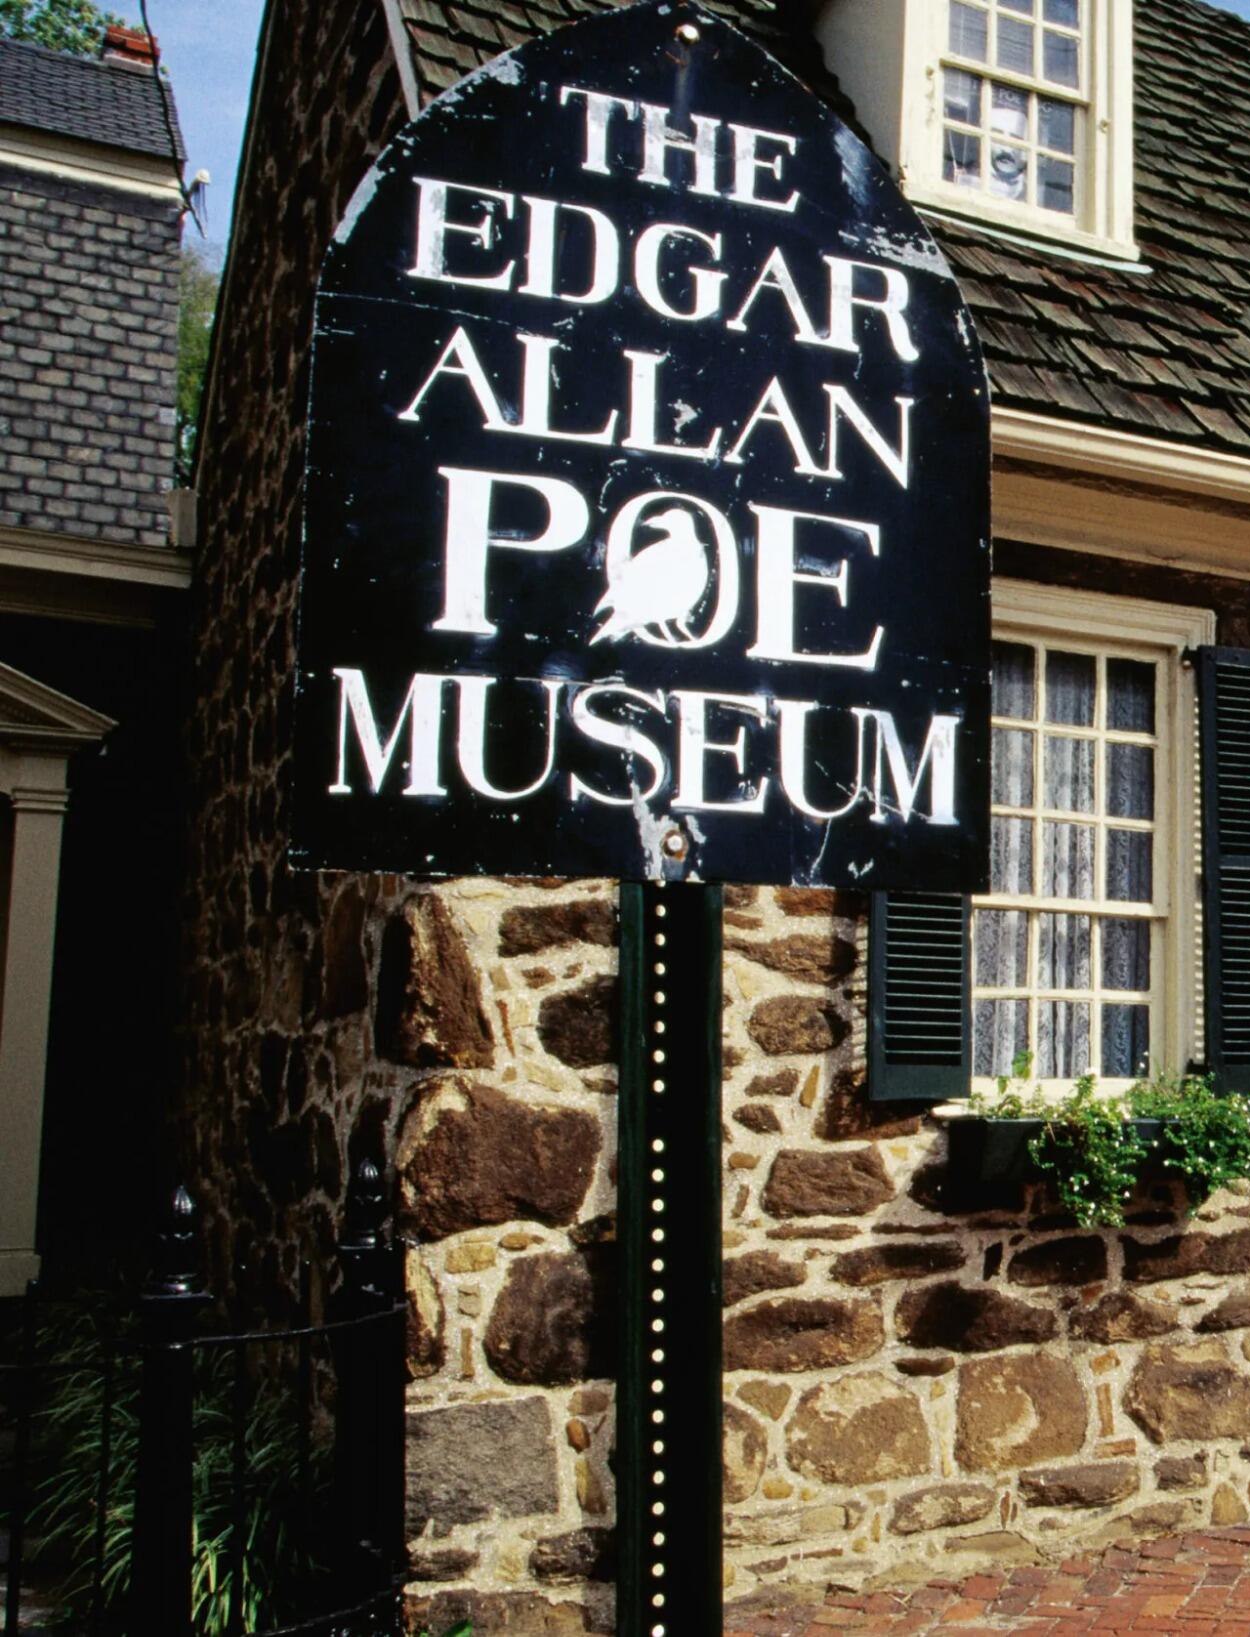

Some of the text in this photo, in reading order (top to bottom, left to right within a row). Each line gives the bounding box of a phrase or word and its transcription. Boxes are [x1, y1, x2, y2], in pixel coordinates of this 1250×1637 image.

[561, 86, 800, 213] THE
[406, 176, 920, 363] EDGAR
[398, 326, 915, 490] ALLAN
[432, 466, 885, 672] POE
[328, 667, 962, 825] MUSEUM
